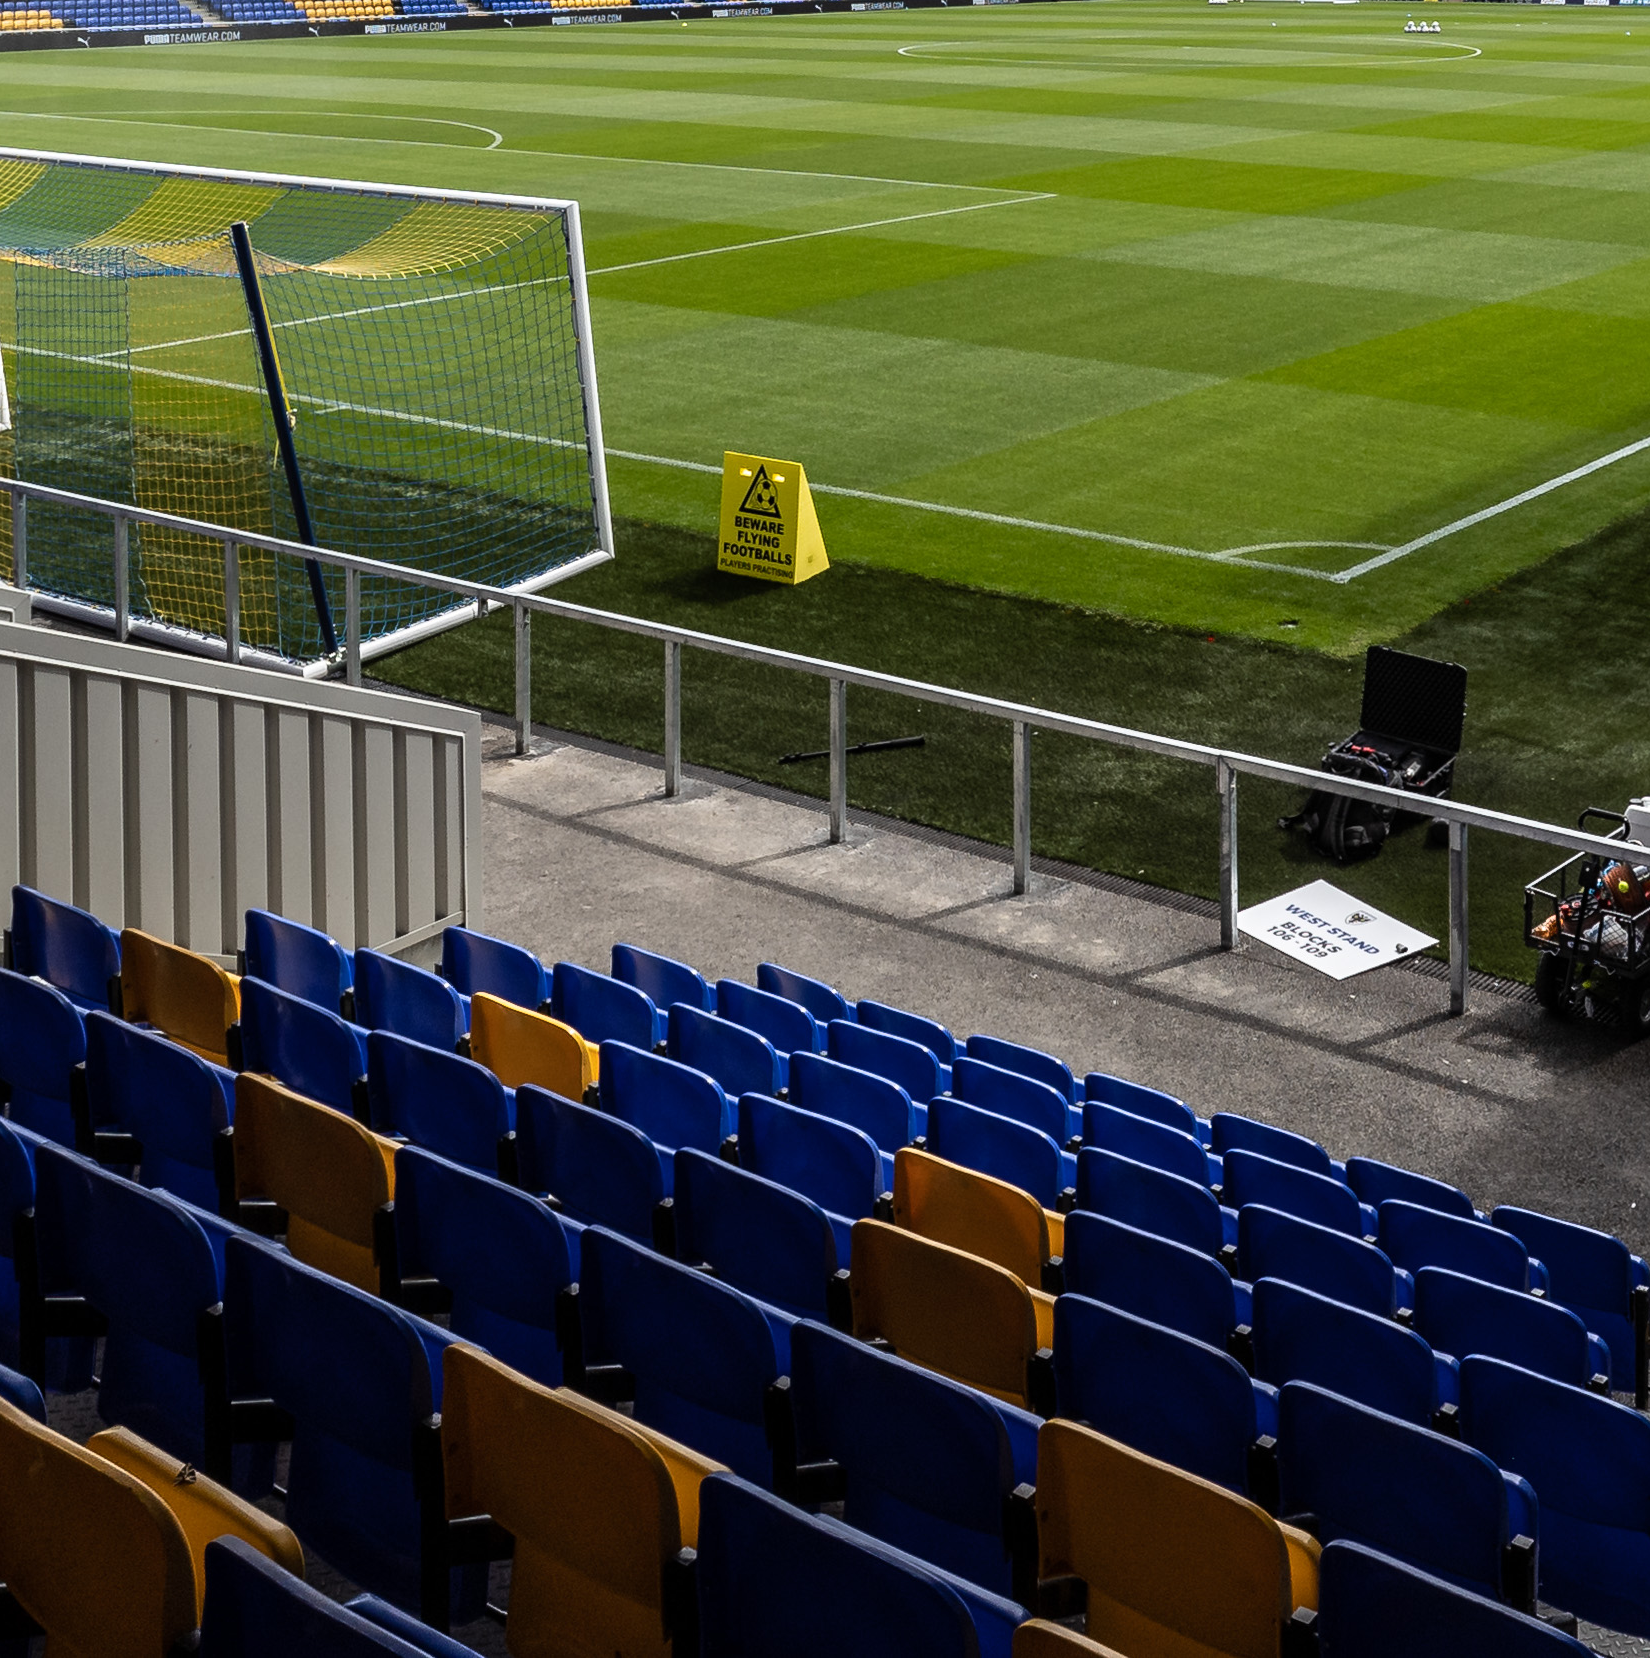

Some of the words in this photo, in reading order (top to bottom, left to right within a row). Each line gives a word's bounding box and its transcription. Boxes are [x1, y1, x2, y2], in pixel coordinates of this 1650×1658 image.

[143, 31, 241, 45] PUMATEAMWEAR.COM
[735, 516, 784, 535] BEWARE
[738, 531, 779, 548] FLYING
[724, 542, 792, 565] FOOTBALLS
[720, 558, 751, 570] PLAYERS
[753, 564, 793, 579] PRACTISING
[1280, 921, 1343, 954] BLOCKS
[1285, 904, 1332, 929] WEST
[1327, 926, 1380, 955] STAND
[1266, 925, 1294, 942] 106
[1299, 942, 1329, 959] 109
